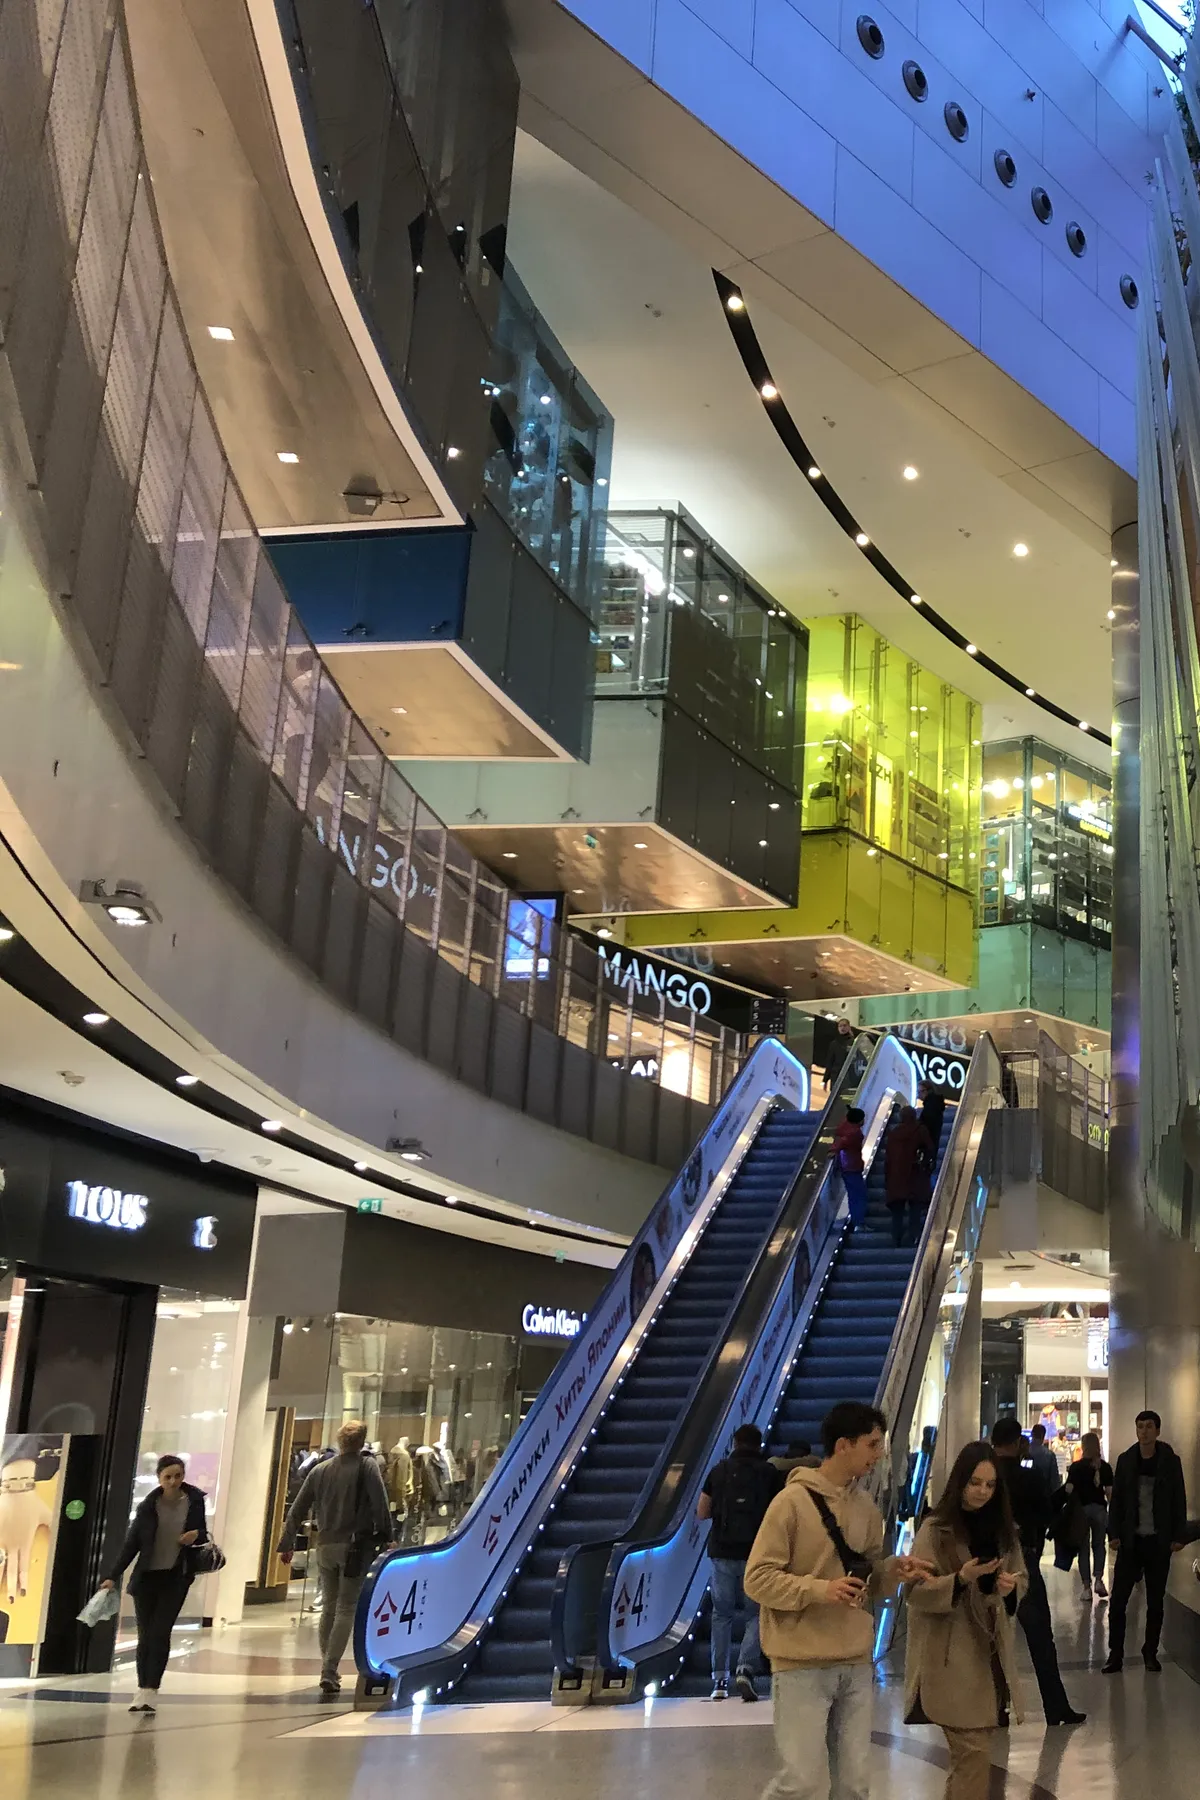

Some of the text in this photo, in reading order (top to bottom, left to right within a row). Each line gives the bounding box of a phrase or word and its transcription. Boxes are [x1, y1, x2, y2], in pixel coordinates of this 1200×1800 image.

[598, 945, 711, 1015] MANGO
[522, 1304, 580, 1336] Calvin Klein
[503, 1429, 550, 1516] ТАНУКИ
[399, 1579, 418, 1635] 4
[631, 1572, 645, 1628] 4
